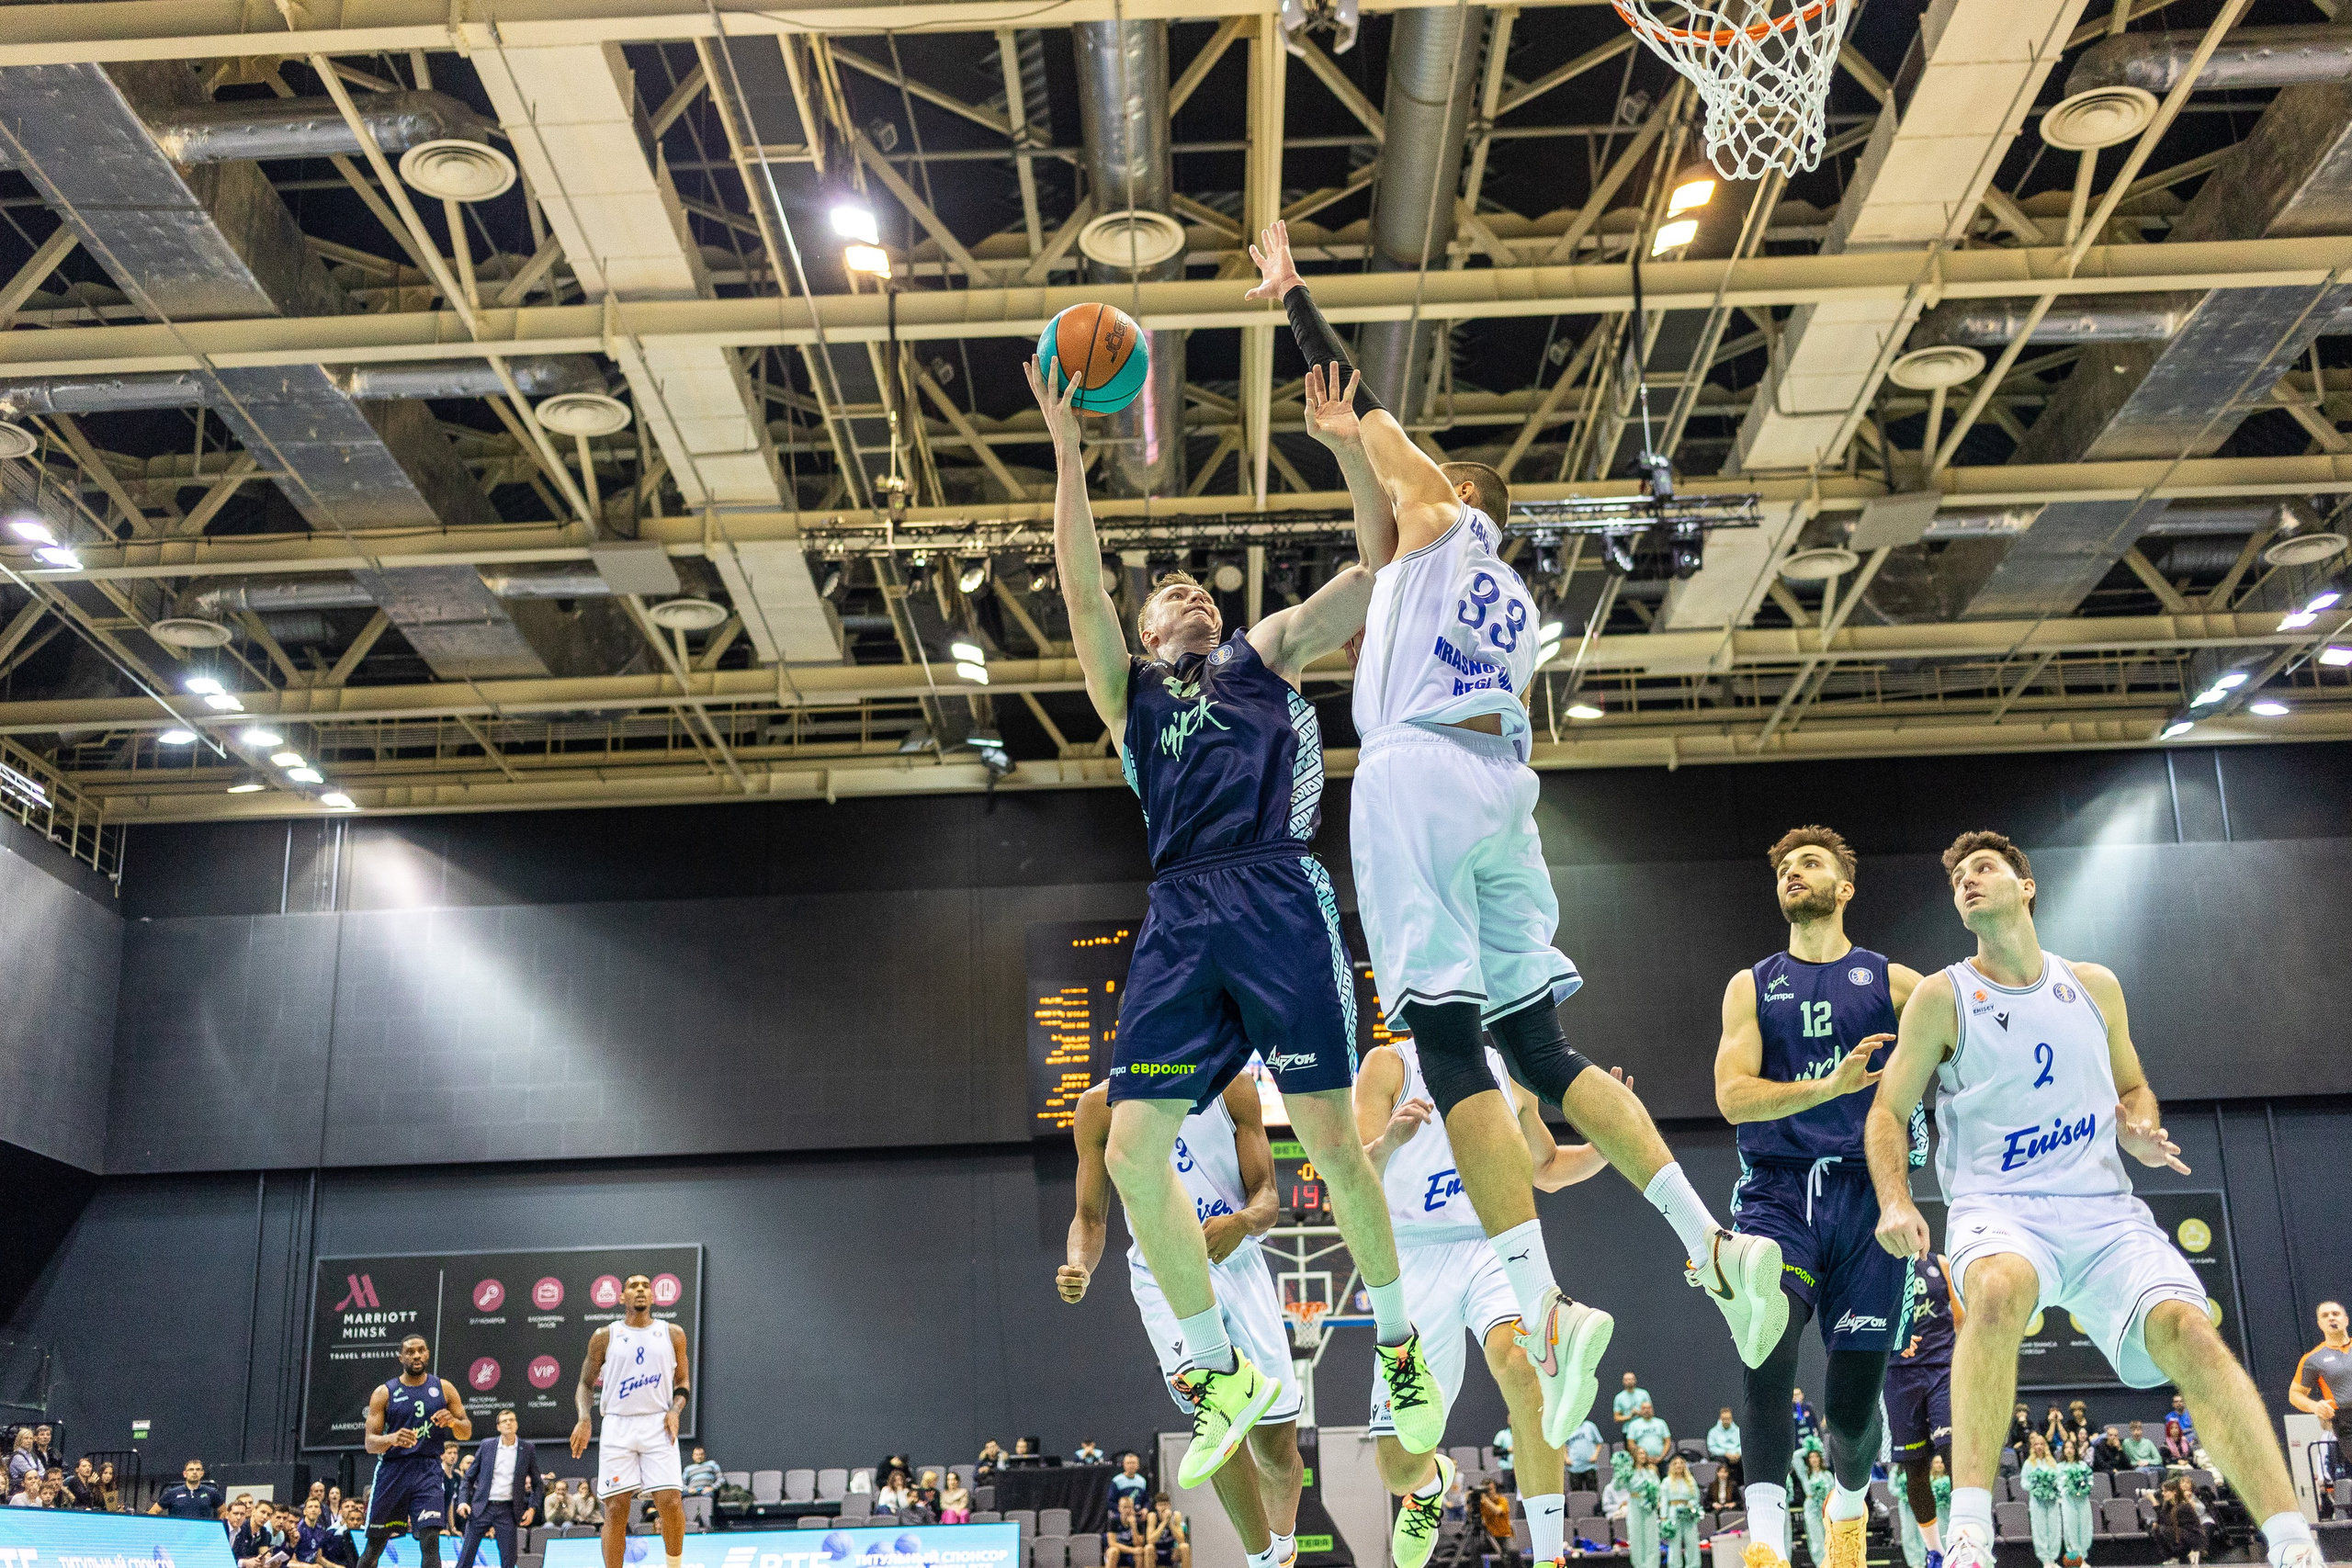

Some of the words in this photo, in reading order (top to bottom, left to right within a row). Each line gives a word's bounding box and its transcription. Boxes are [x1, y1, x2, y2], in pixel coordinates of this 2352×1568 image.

[1458, 573, 1526, 653] 33
[1800, 1000, 1833, 1038] 12
[1130, 1063, 1196, 1077] евроопт
[2033, 1043, 2054, 1089] 2
[2001, 1113, 2096, 1172] Enisey
[1292, 1185, 1318, 1209] 19
[343, 1311, 418, 1325] MARRIOTT
[342, 1326, 387, 1338] MINSK
[330, 1349, 359, 1359] TRAVEL
[636, 1347, 645, 1365] 8
[533, 1365, 556, 1378] VIP
[619, 1372, 662, 1400] Enisey
[414, 1400, 424, 1418] 3
